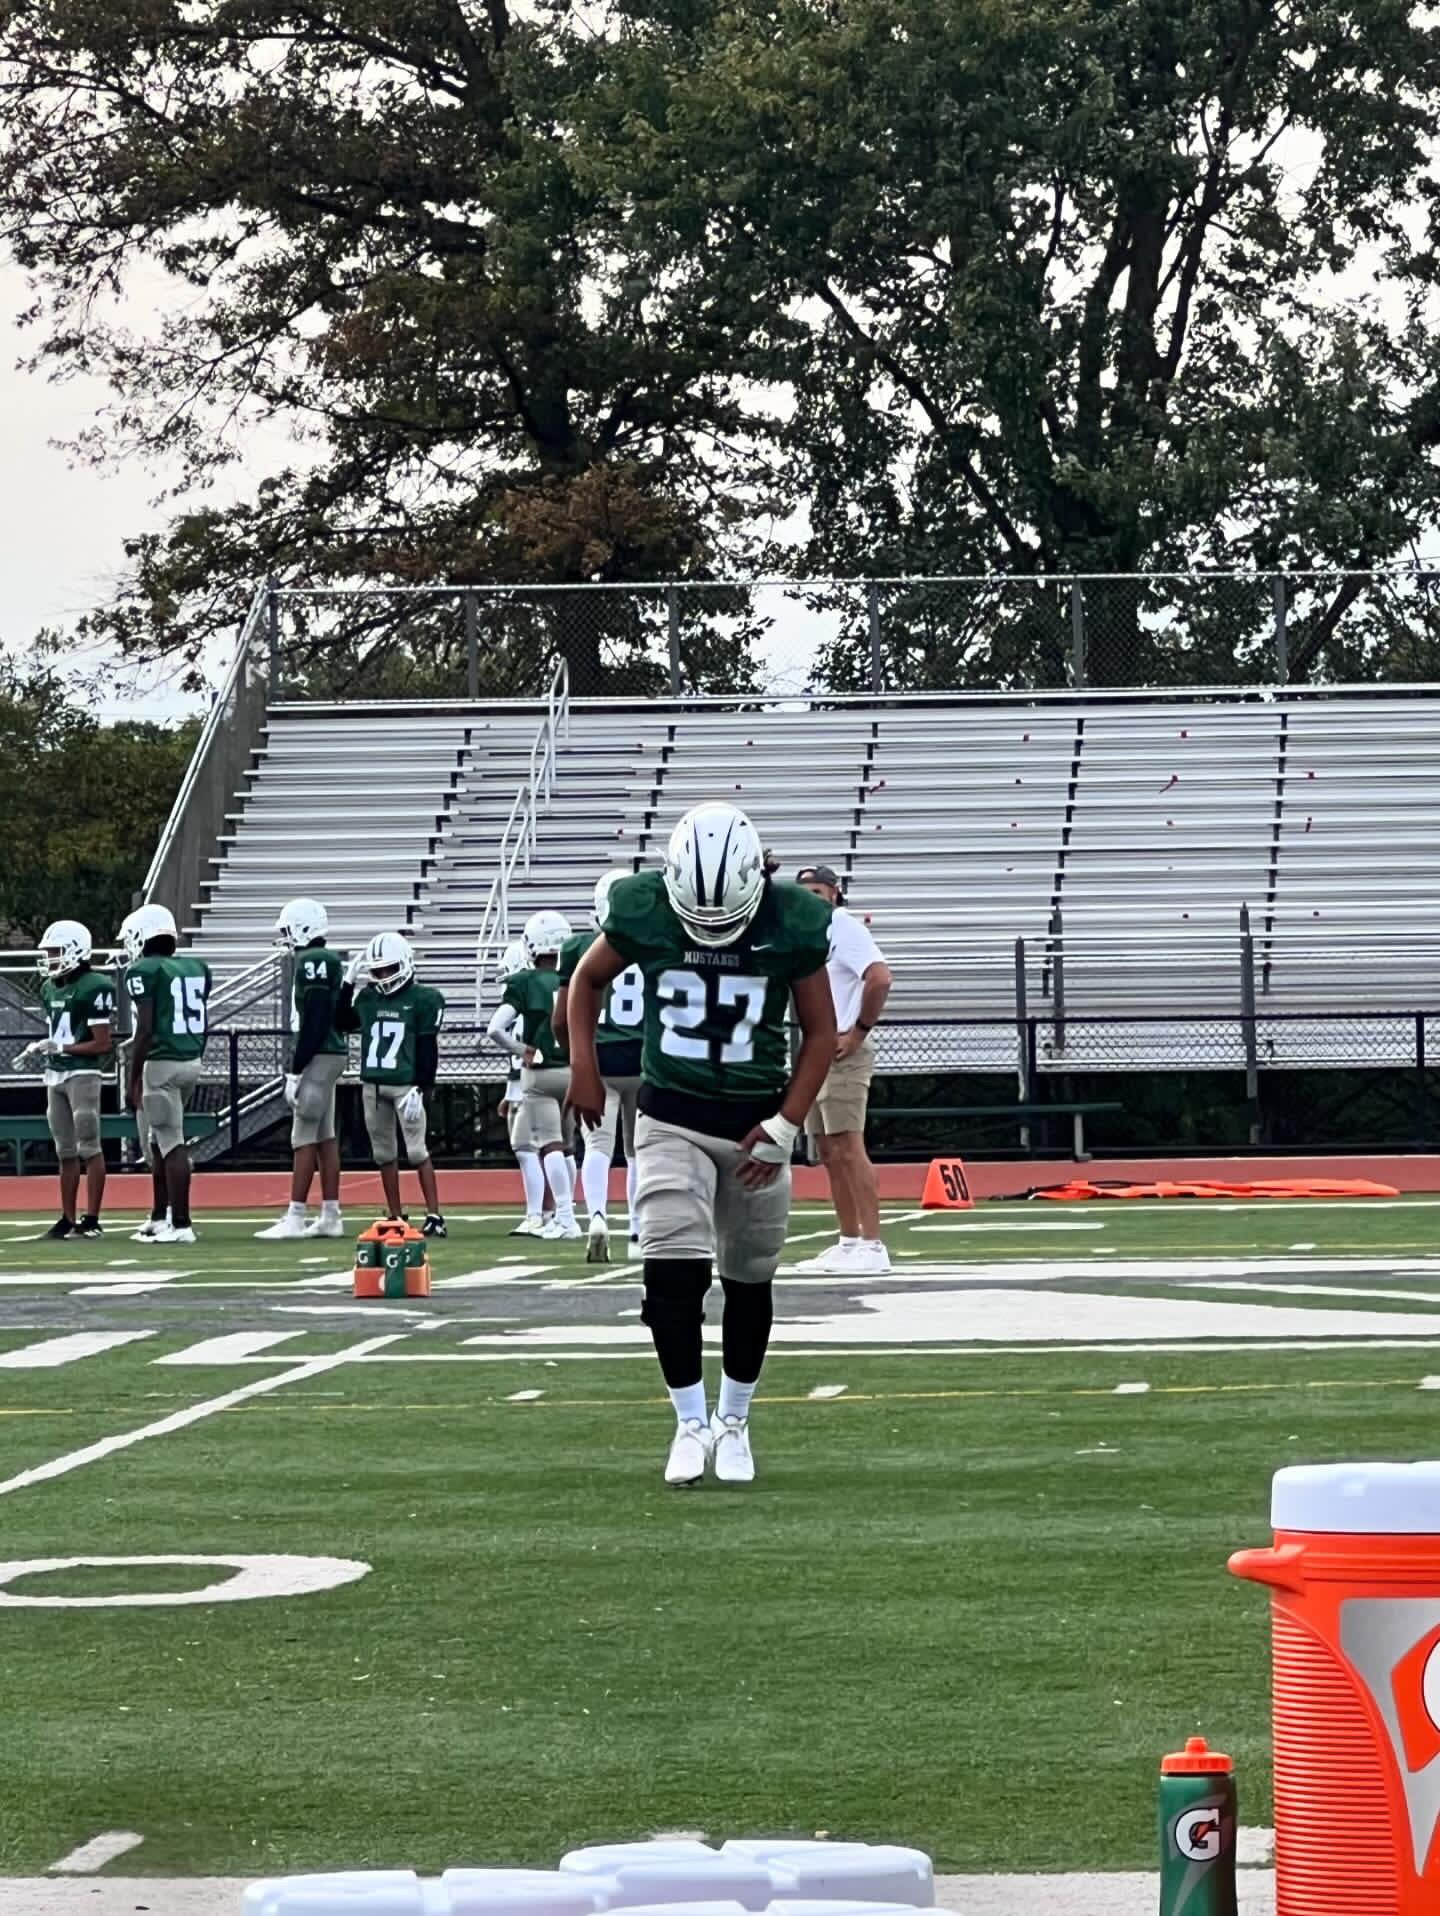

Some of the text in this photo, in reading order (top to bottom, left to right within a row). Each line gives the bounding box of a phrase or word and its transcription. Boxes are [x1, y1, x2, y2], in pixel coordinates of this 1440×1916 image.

[304, 961, 327, 980] 34
[94, 992, 113, 1011] 44
[170, 976, 205, 1034] 15
[656, 969, 769, 1063] 27
[366, 1021, 405, 1069] 17
[939, 1164, 970, 1201] 50
[358, 1250, 369, 1264] G
[386, 1254, 399, 1269] G
[1175, 1808, 1221, 1861] G
